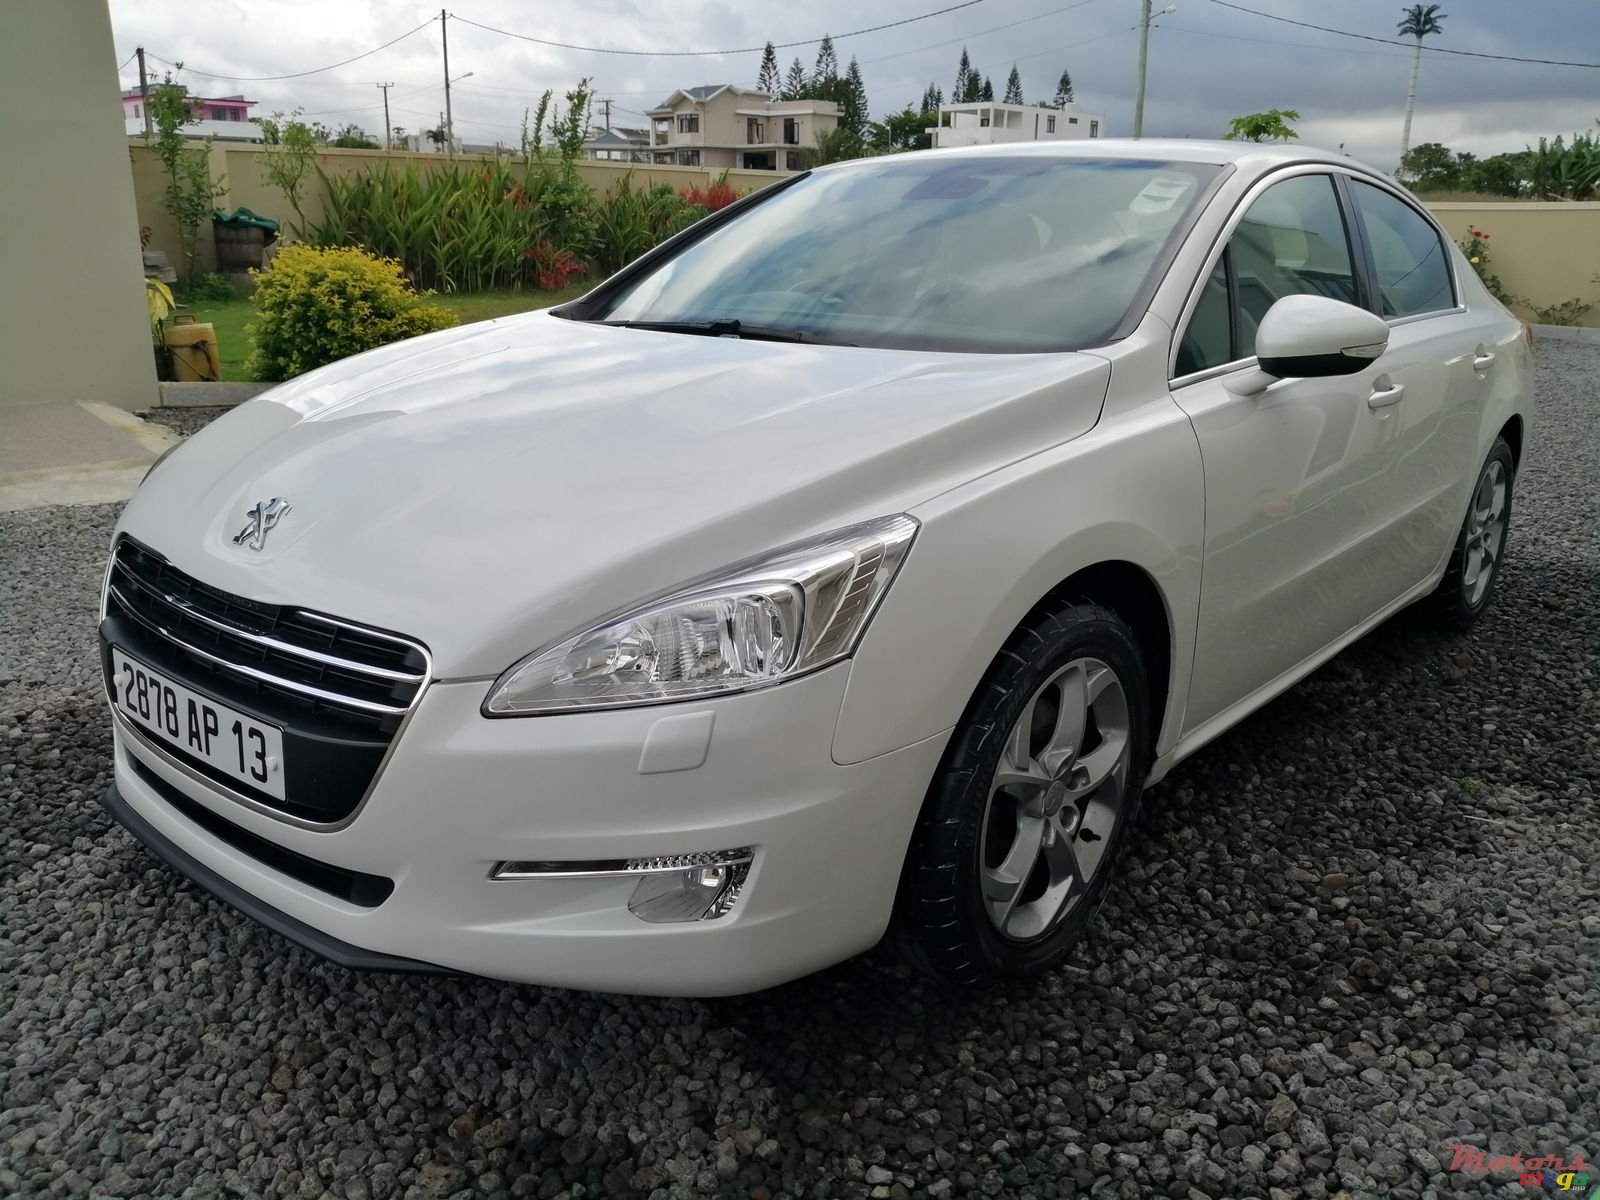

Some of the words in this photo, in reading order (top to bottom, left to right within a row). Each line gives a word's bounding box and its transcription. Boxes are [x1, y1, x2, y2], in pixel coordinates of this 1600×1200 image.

[123, 662, 179, 738] 2878
[188, 698, 219, 757] AP
[232, 720, 268, 784] 13
